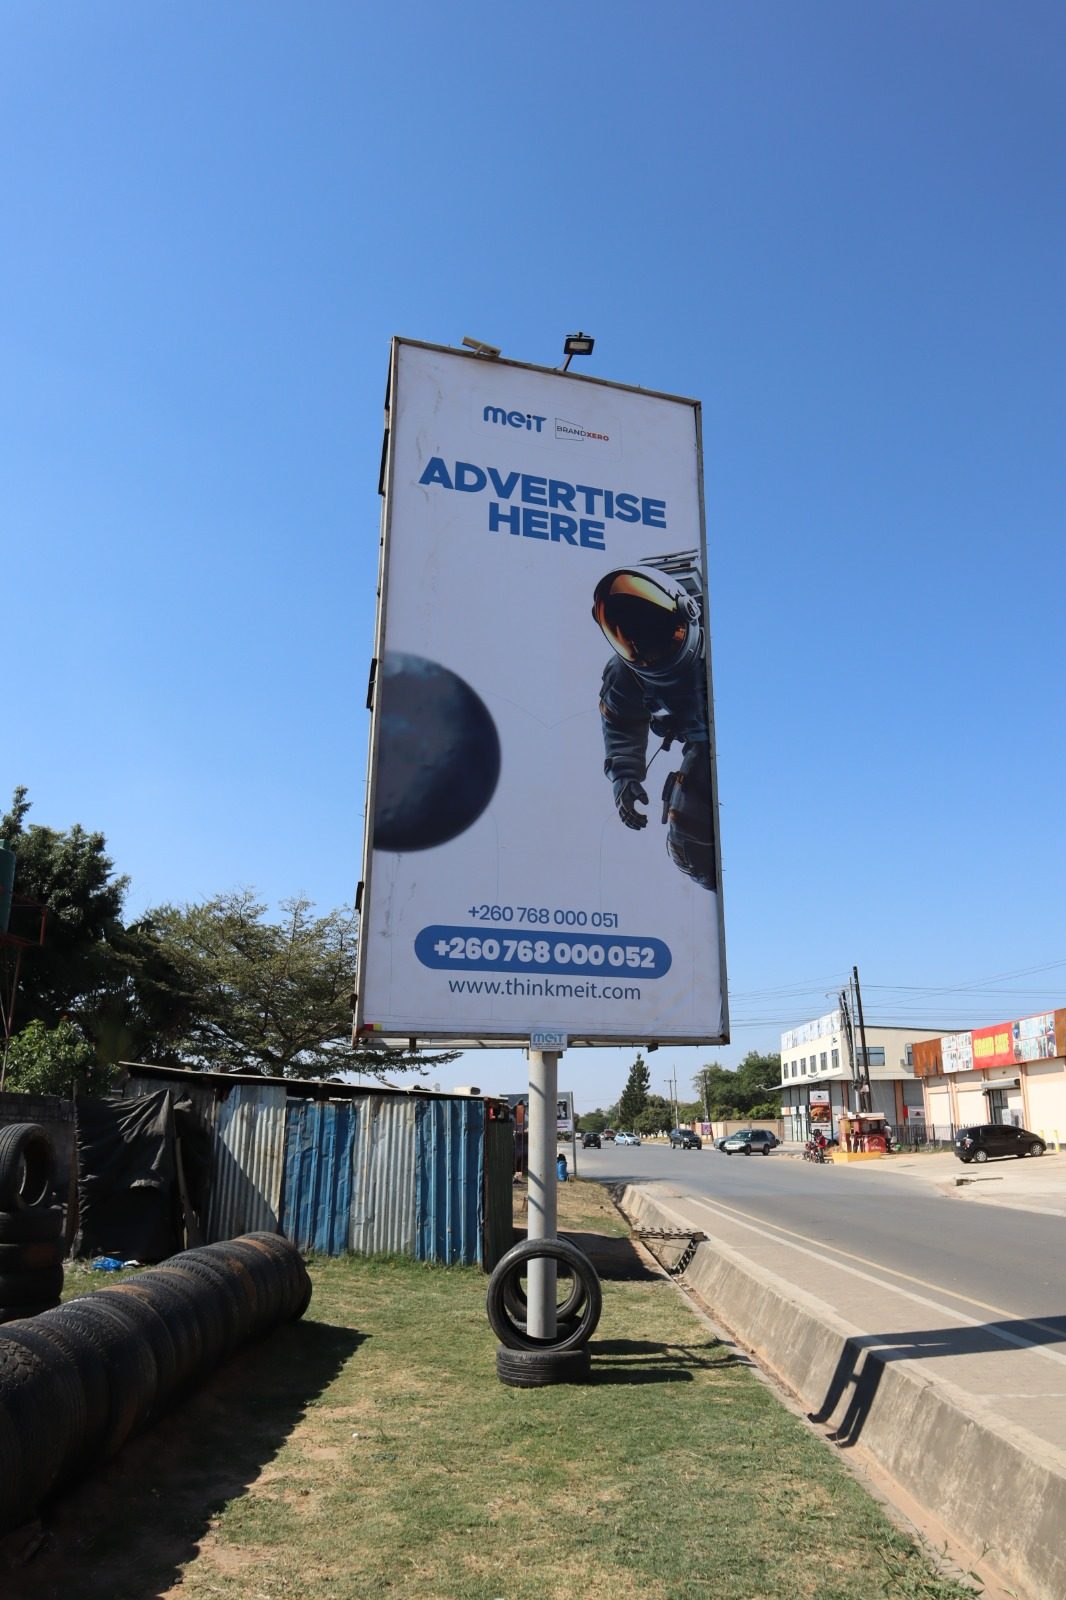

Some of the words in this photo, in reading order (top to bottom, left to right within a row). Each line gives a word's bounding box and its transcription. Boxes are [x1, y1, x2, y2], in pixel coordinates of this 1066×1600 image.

[556, 425, 609, 441] BRANDXERO
[418, 456, 667, 529] ADVERTISE
[489, 501, 606, 551] HERE
[468, 904, 514, 922] +260
[517, 907, 550, 925] 768
[554, 910, 588, 926] 000
[591, 912, 619, 928] 051
[434, 937, 500, 960] +260
[503, 939, 551, 964] 768
[554, 943, 606, 966] 000
[608, 945, 655, 968] 052
[448, 978, 641, 1000] www.thinkmeit.com
